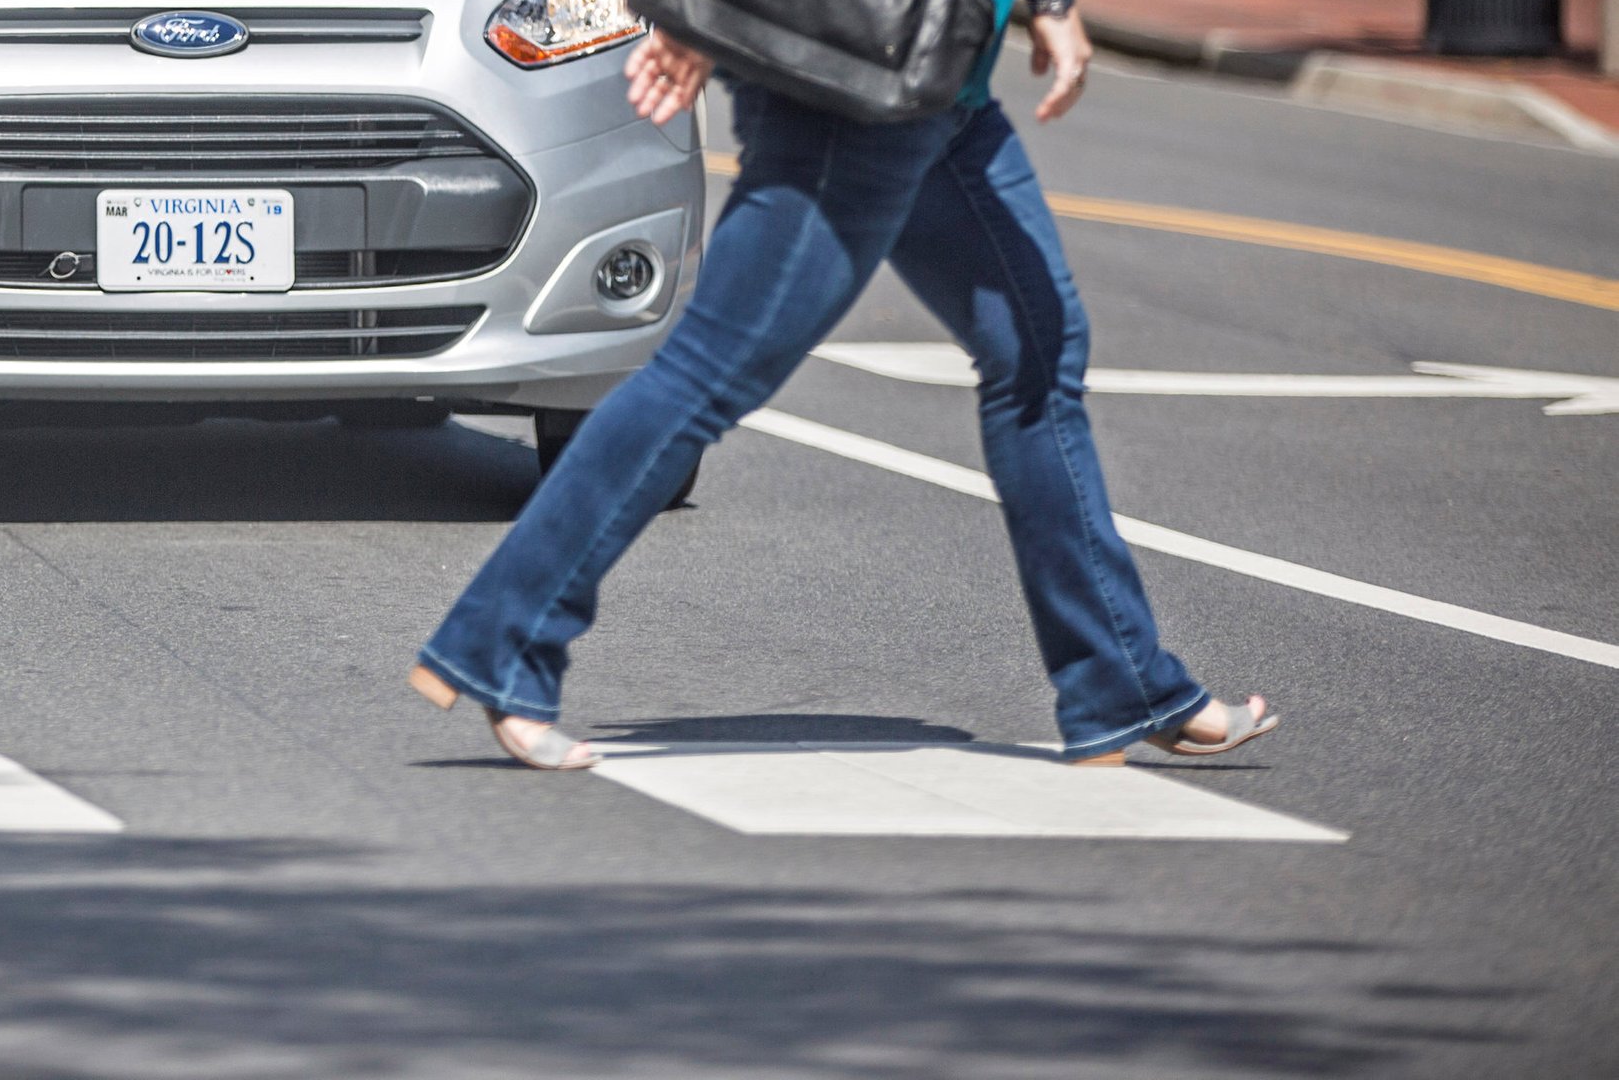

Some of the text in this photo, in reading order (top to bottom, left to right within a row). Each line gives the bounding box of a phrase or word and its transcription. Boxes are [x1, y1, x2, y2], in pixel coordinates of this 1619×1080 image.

[157, 18, 220, 43] Ford
[106, 206, 128, 217] MAR
[150, 198, 241, 214] VIRGINIA
[266, 205, 282, 215] 19
[132, 220, 255, 265] 20-12S
[147, 268, 185, 276] VIRGINIA
[195, 268, 213, 276] FOR
